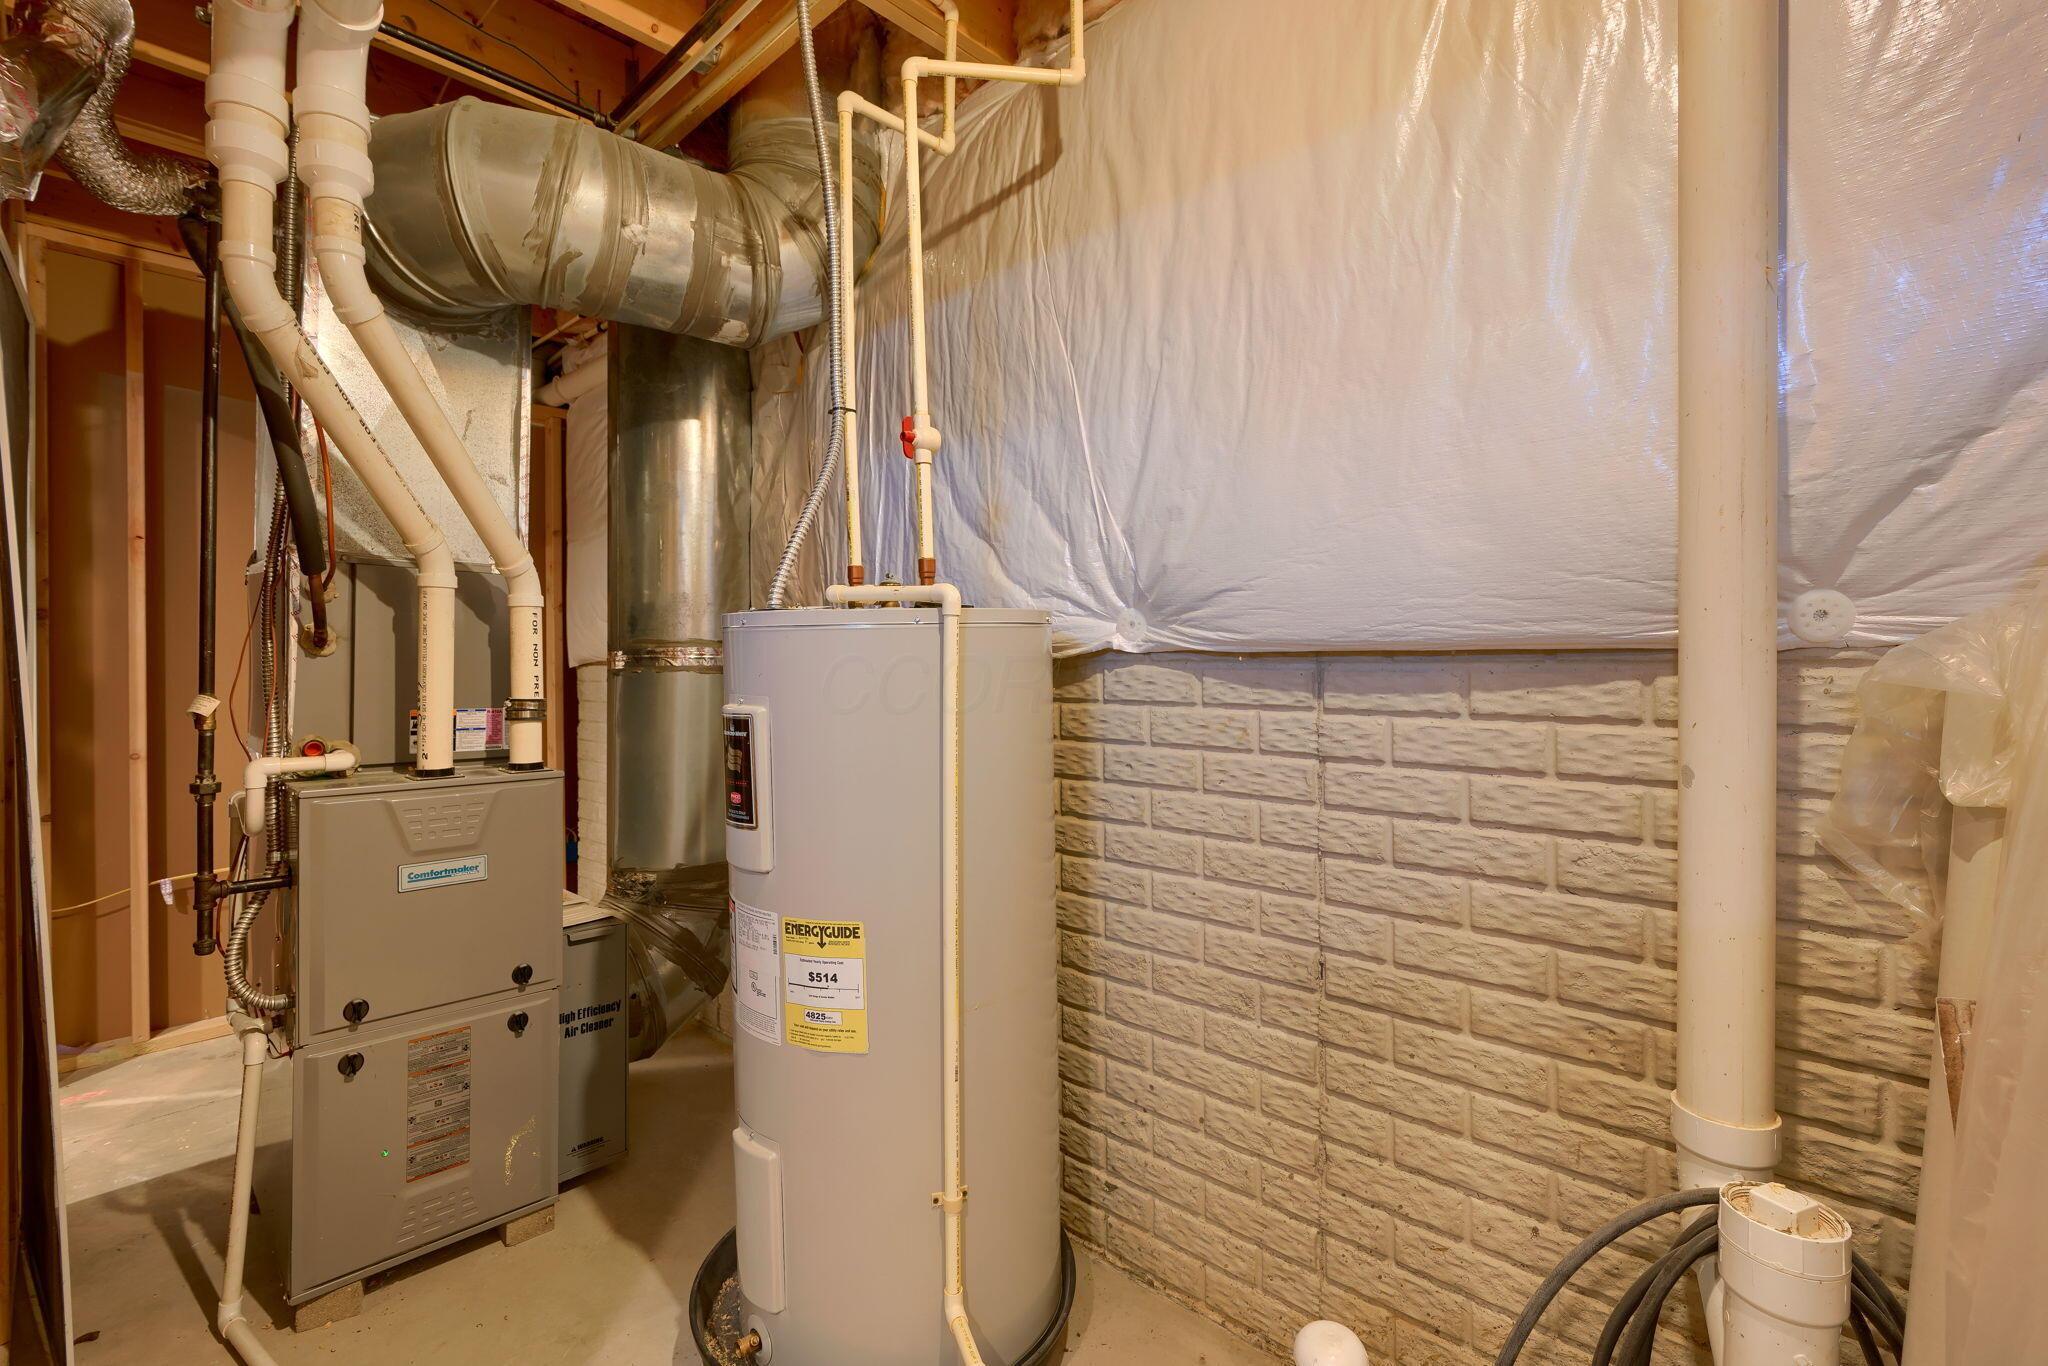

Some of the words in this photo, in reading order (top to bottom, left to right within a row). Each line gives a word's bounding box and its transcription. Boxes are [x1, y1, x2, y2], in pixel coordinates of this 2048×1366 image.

[407, 865, 479, 880] Comfortmaker
[784, 922, 860, 939] ENERGYGUIDE
[808, 971, 838, 984] $514
[577, 1000, 622, 1020] Efficiency
[805, 1011, 826, 1021] 4825
[564, 1026, 579, 1039] Air
[580, 1017, 614, 1035] Cleaner
